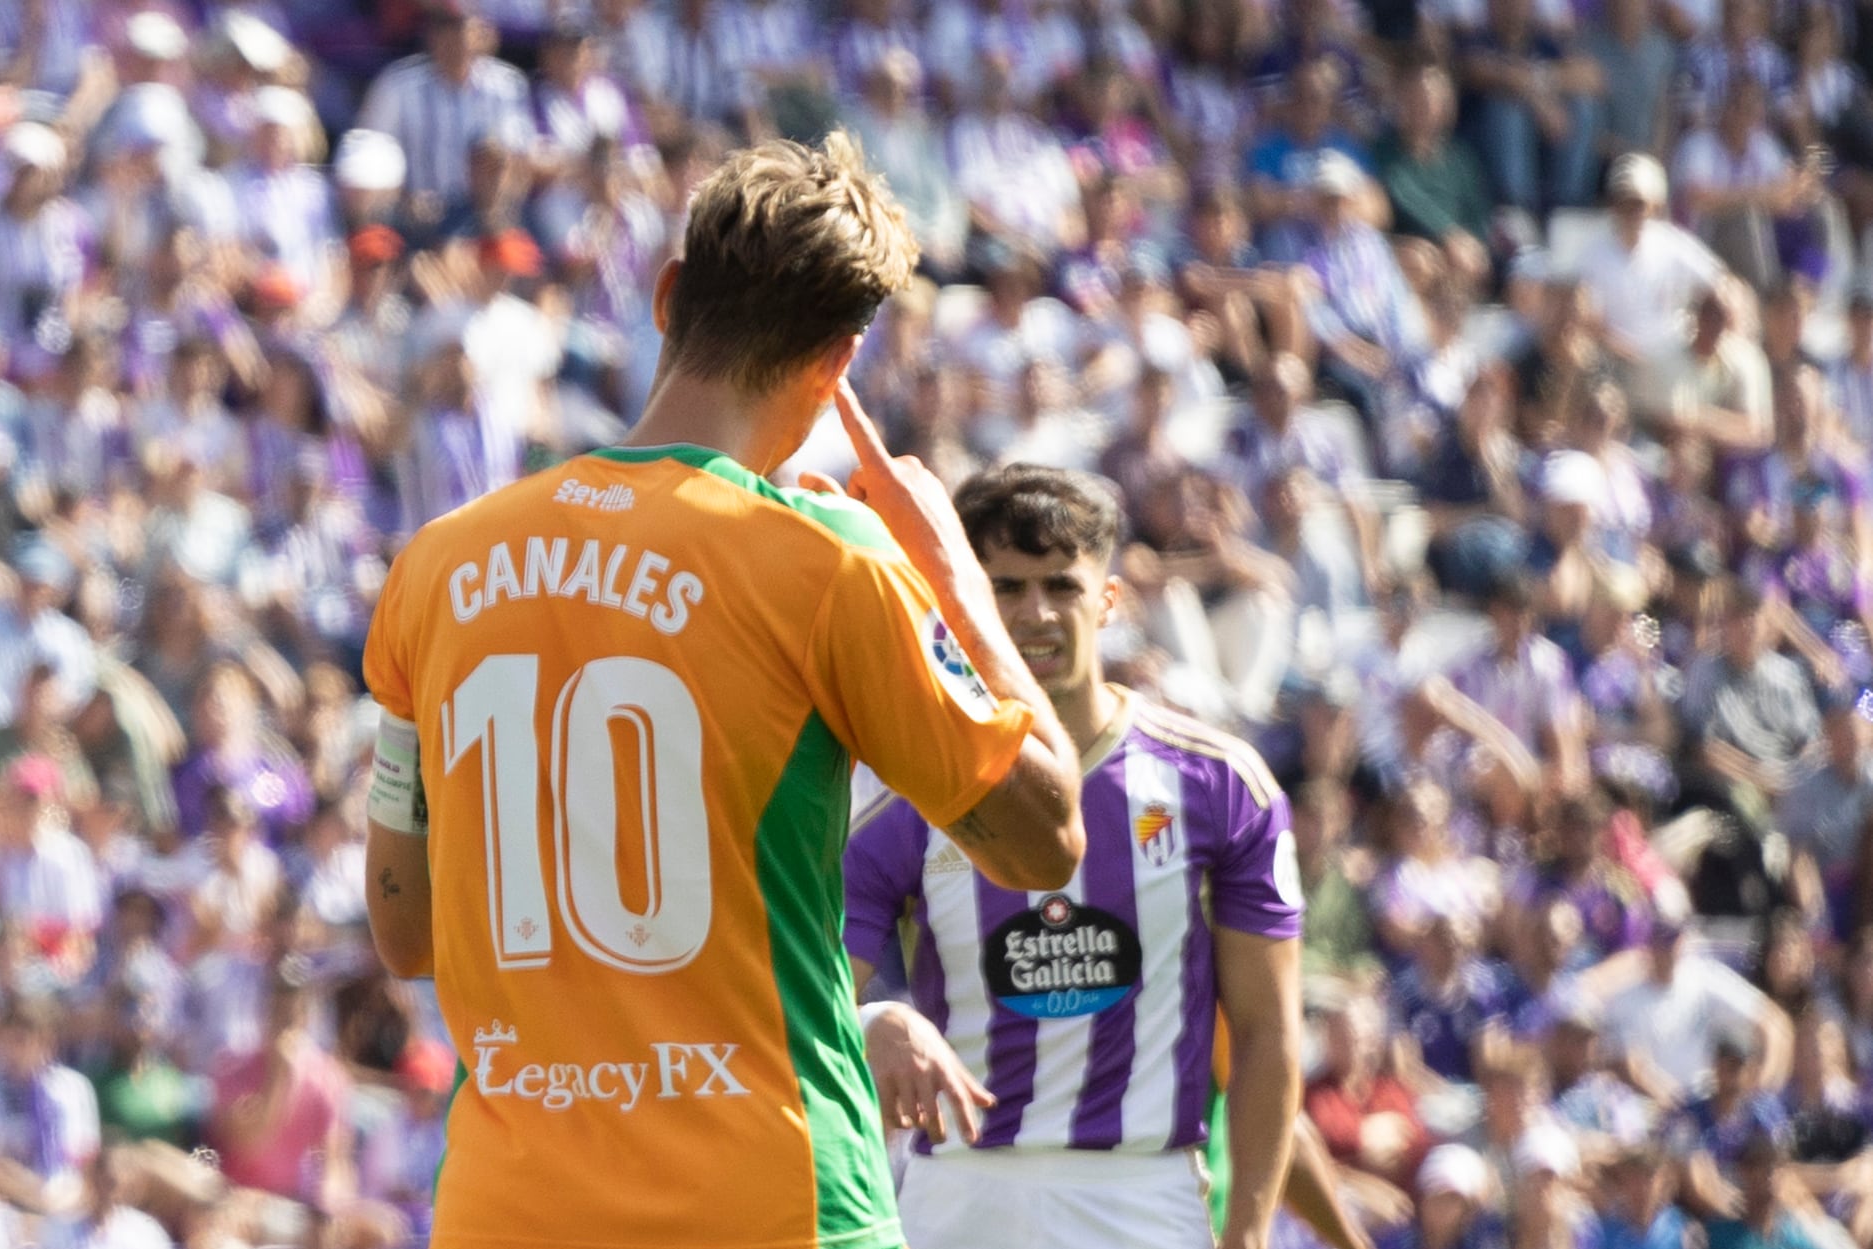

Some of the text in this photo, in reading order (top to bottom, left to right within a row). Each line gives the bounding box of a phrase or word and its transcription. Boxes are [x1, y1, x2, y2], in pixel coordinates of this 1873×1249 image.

[449, 535, 704, 635] CANALES
[441, 653, 712, 975] 10
[1004, 925, 1117, 961] Estrella
[1010, 954, 1115, 992] Galicia
